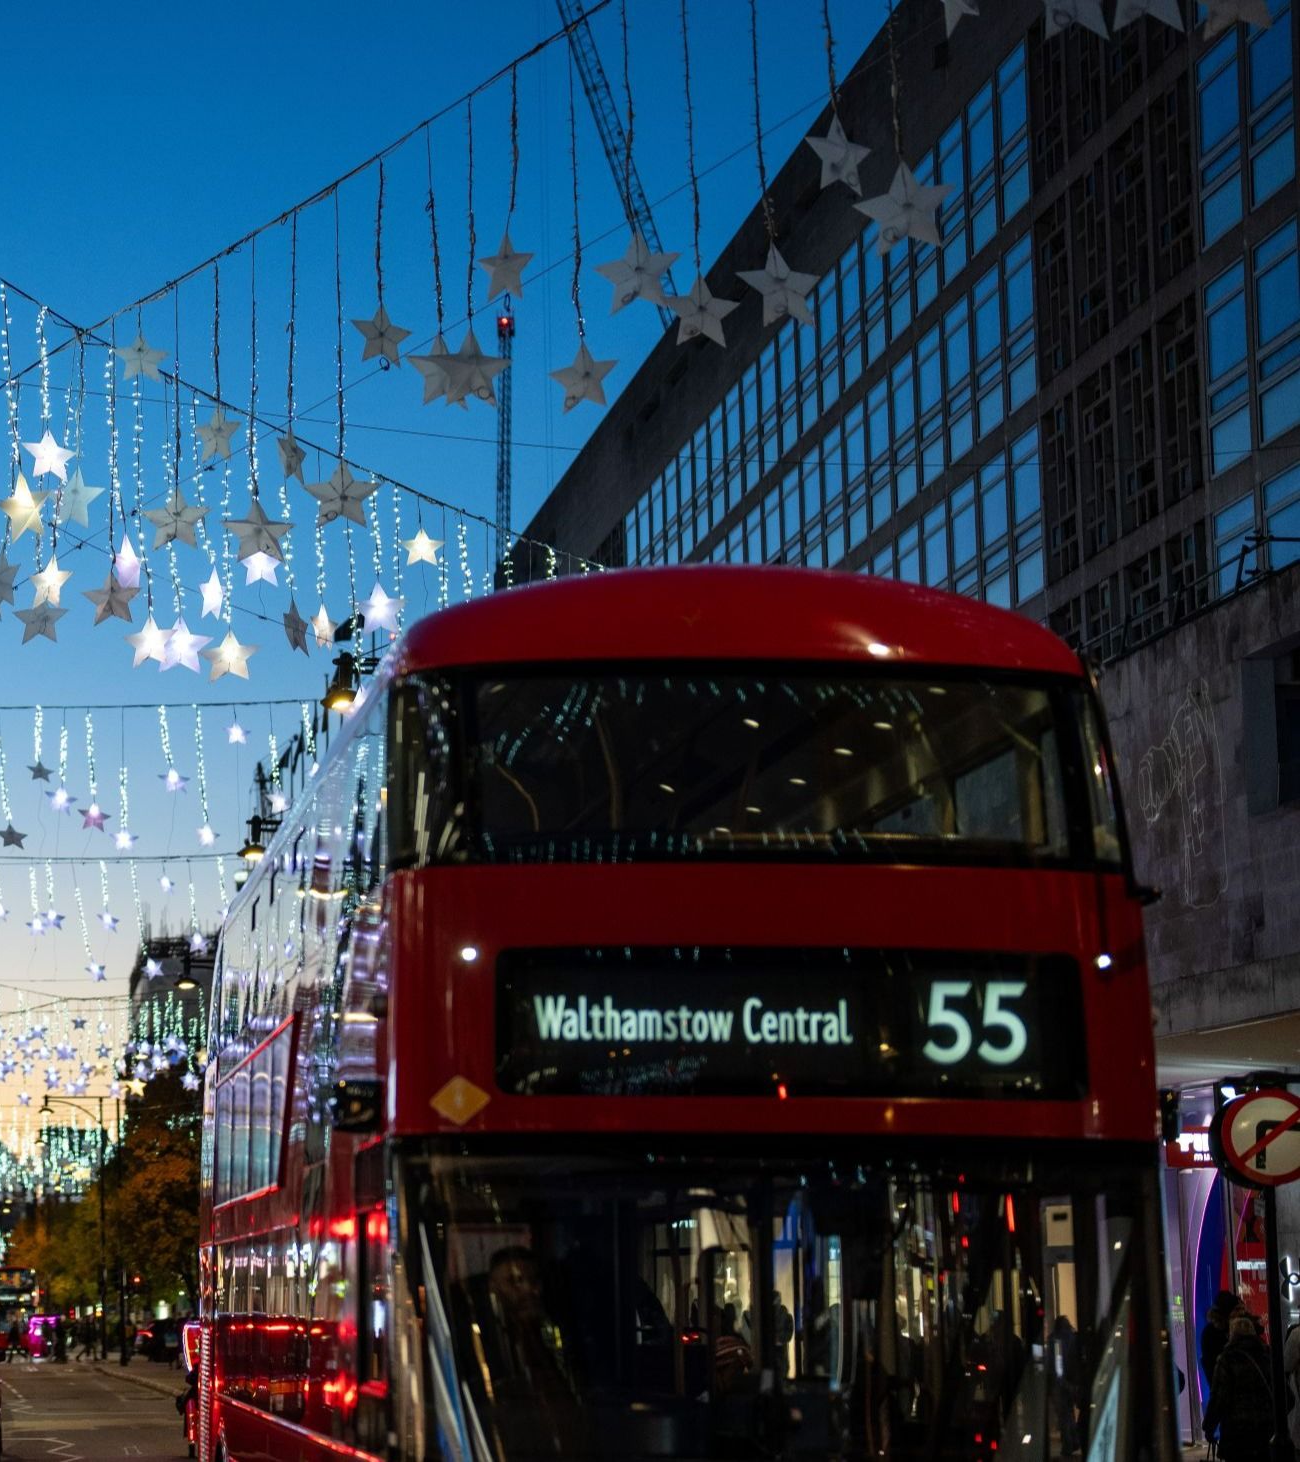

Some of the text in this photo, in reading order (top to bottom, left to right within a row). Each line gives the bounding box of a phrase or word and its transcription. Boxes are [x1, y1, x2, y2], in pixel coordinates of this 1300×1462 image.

[534, 981, 1028, 1065] Walthamstow Central 55
